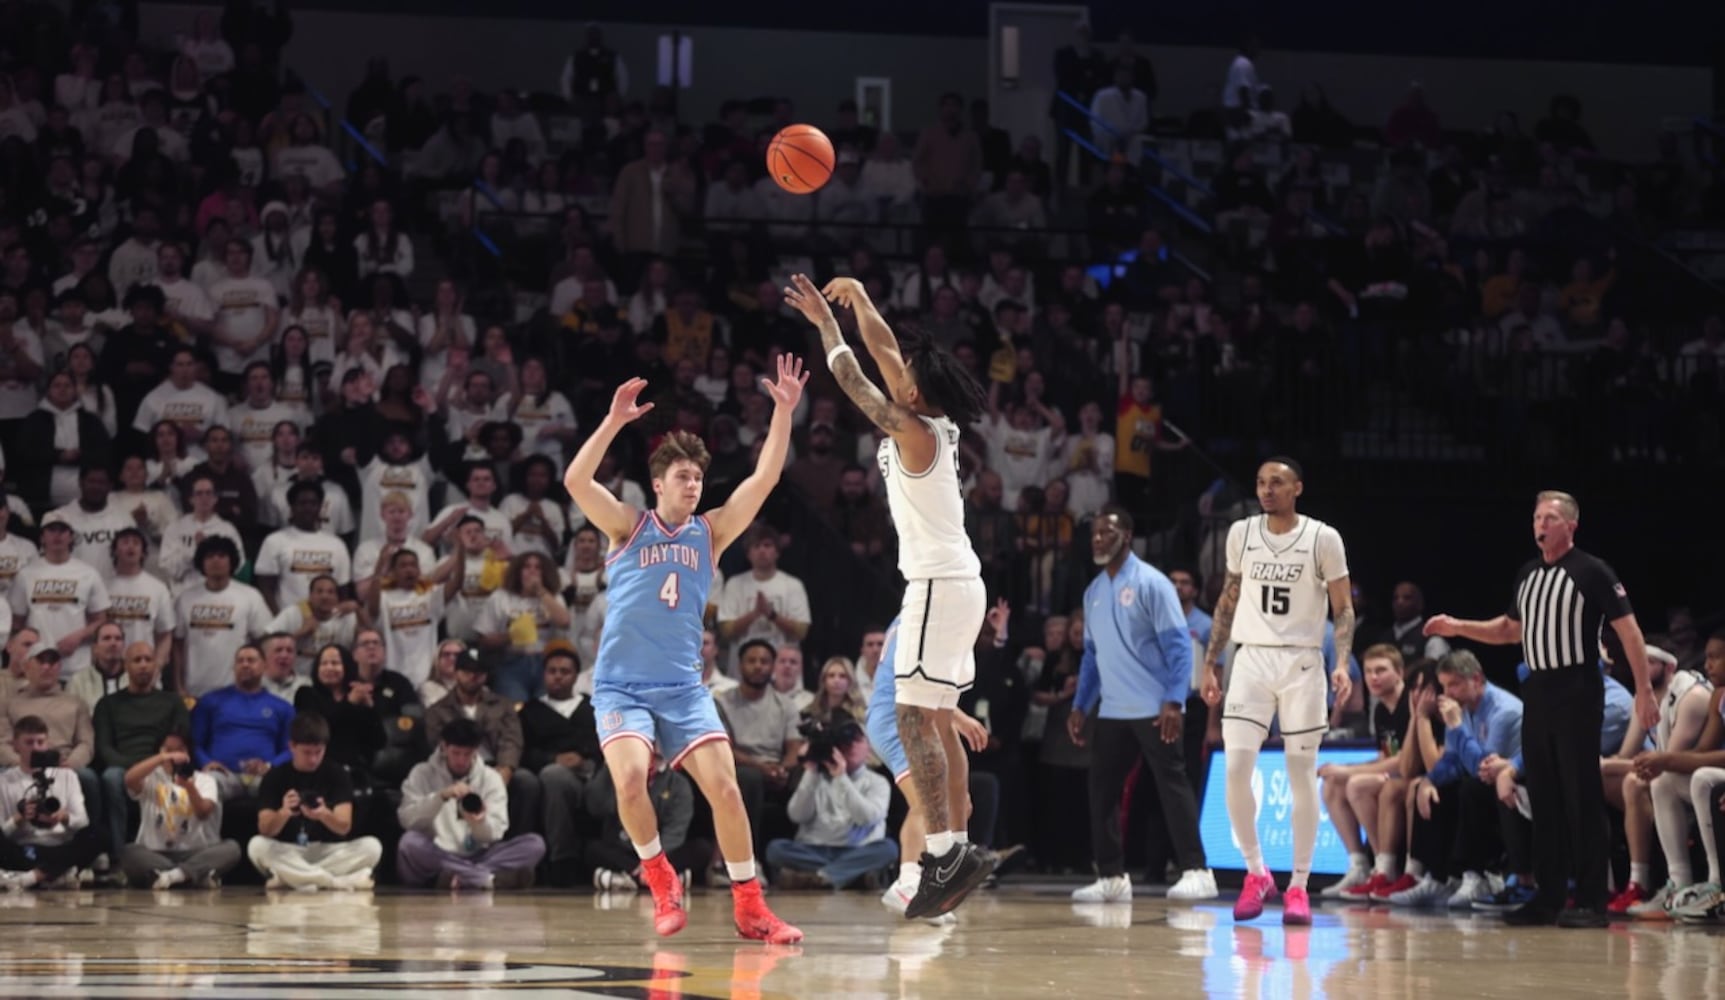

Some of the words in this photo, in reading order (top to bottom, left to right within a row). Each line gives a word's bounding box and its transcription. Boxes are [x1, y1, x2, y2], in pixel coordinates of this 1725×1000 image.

[639, 543, 700, 572] DAYTON
[1250, 562, 1304, 583] RAMS
[33, 580, 78, 597] RAMS
[658, 571, 679, 610] 4
[1261, 585, 1291, 616] 15
[191, 605, 234, 621] RAMS
